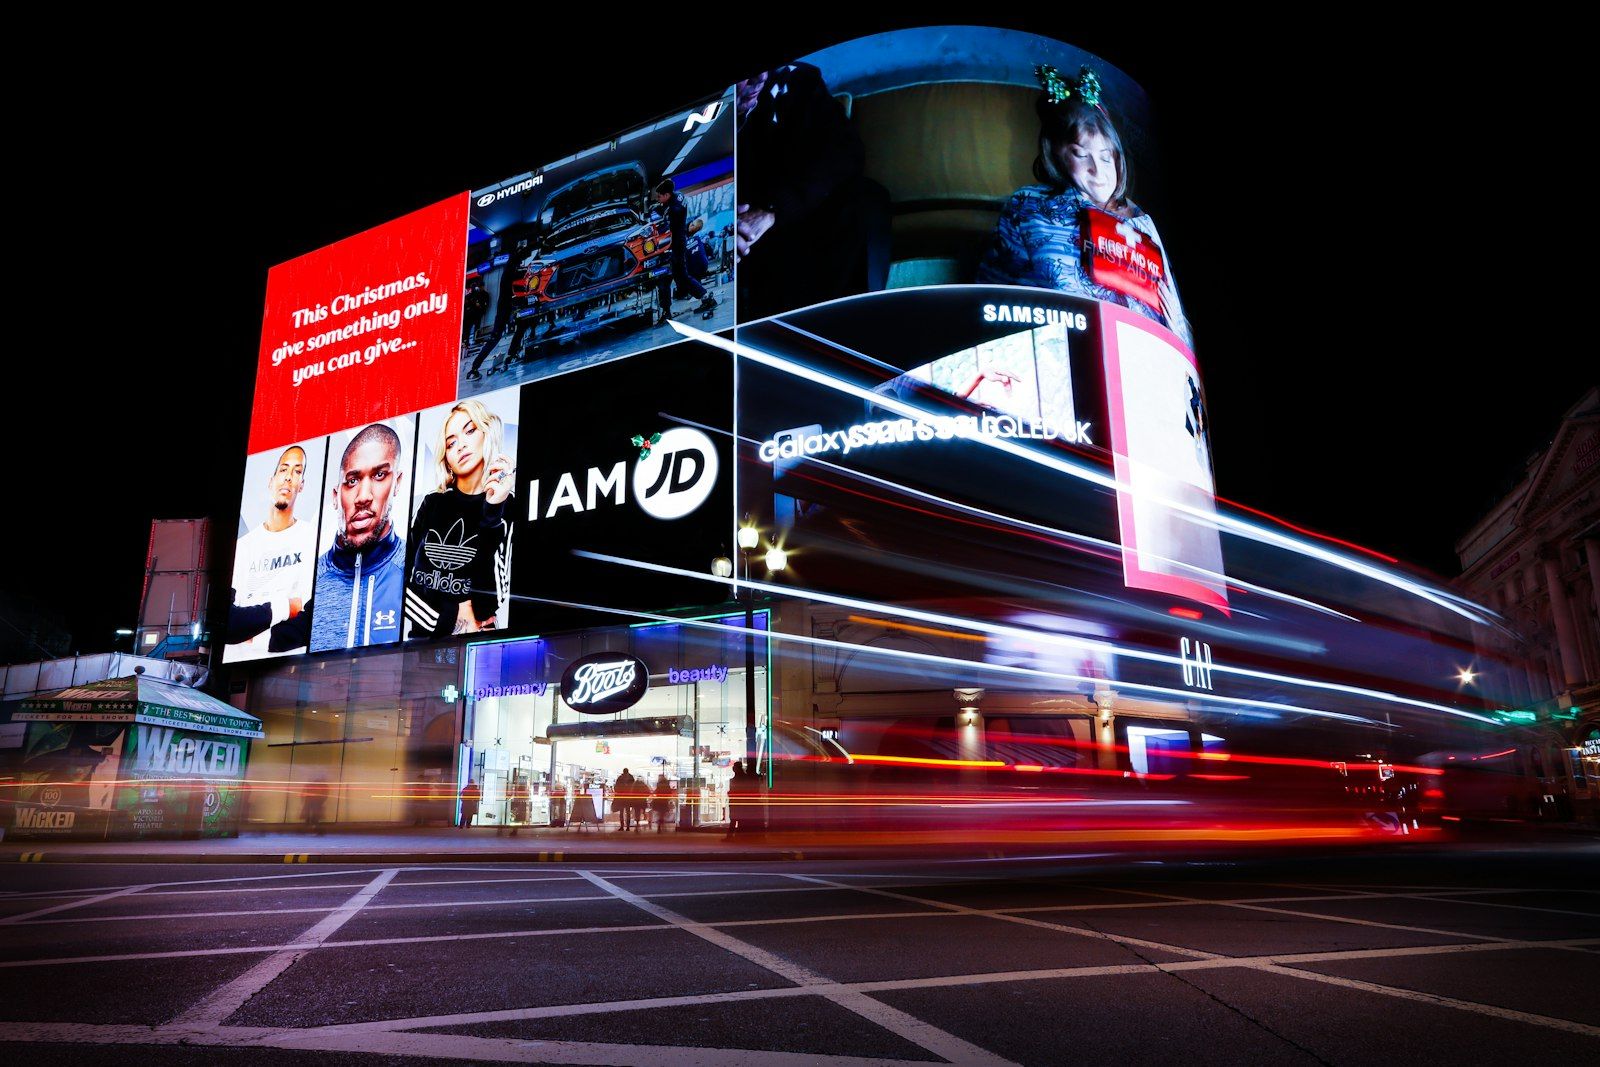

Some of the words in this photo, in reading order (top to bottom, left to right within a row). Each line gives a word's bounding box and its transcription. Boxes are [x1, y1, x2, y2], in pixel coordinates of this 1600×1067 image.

[496, 174, 544, 200] HYUNDAI
[1097, 236, 1129, 262] FIRST
[1130, 250, 1147, 269] AID
[1147, 258, 1161, 279] KIT
[292, 303, 329, 329] This
[330, 271, 431, 316] Christmas,
[983, 303, 1088, 332] SAMSUNG
[271, 341, 304, 367] give
[306, 310, 401, 352] something
[403, 292, 448, 321] only
[292, 360, 325, 387] you
[327, 350, 362, 372] can
[363, 337, 418, 366] give...
[758, 428, 853, 463] Galaxy
[527, 478, 541, 522] I
[544, 460, 627, 519] AM
[645, 447, 706, 499] JD
[415, 569, 473, 595] adidas
[566, 659, 637, 705] Boots
[668, 664, 729, 685] beauty
[1180, 636, 1214, 690] GAP
[476, 681, 548, 701] pharmacy
[173, 708, 192, 720] BEST
[194, 712, 219, 724] SHOW
[219, 717, 229, 725] IN
[44, 791, 58, 800] 100
